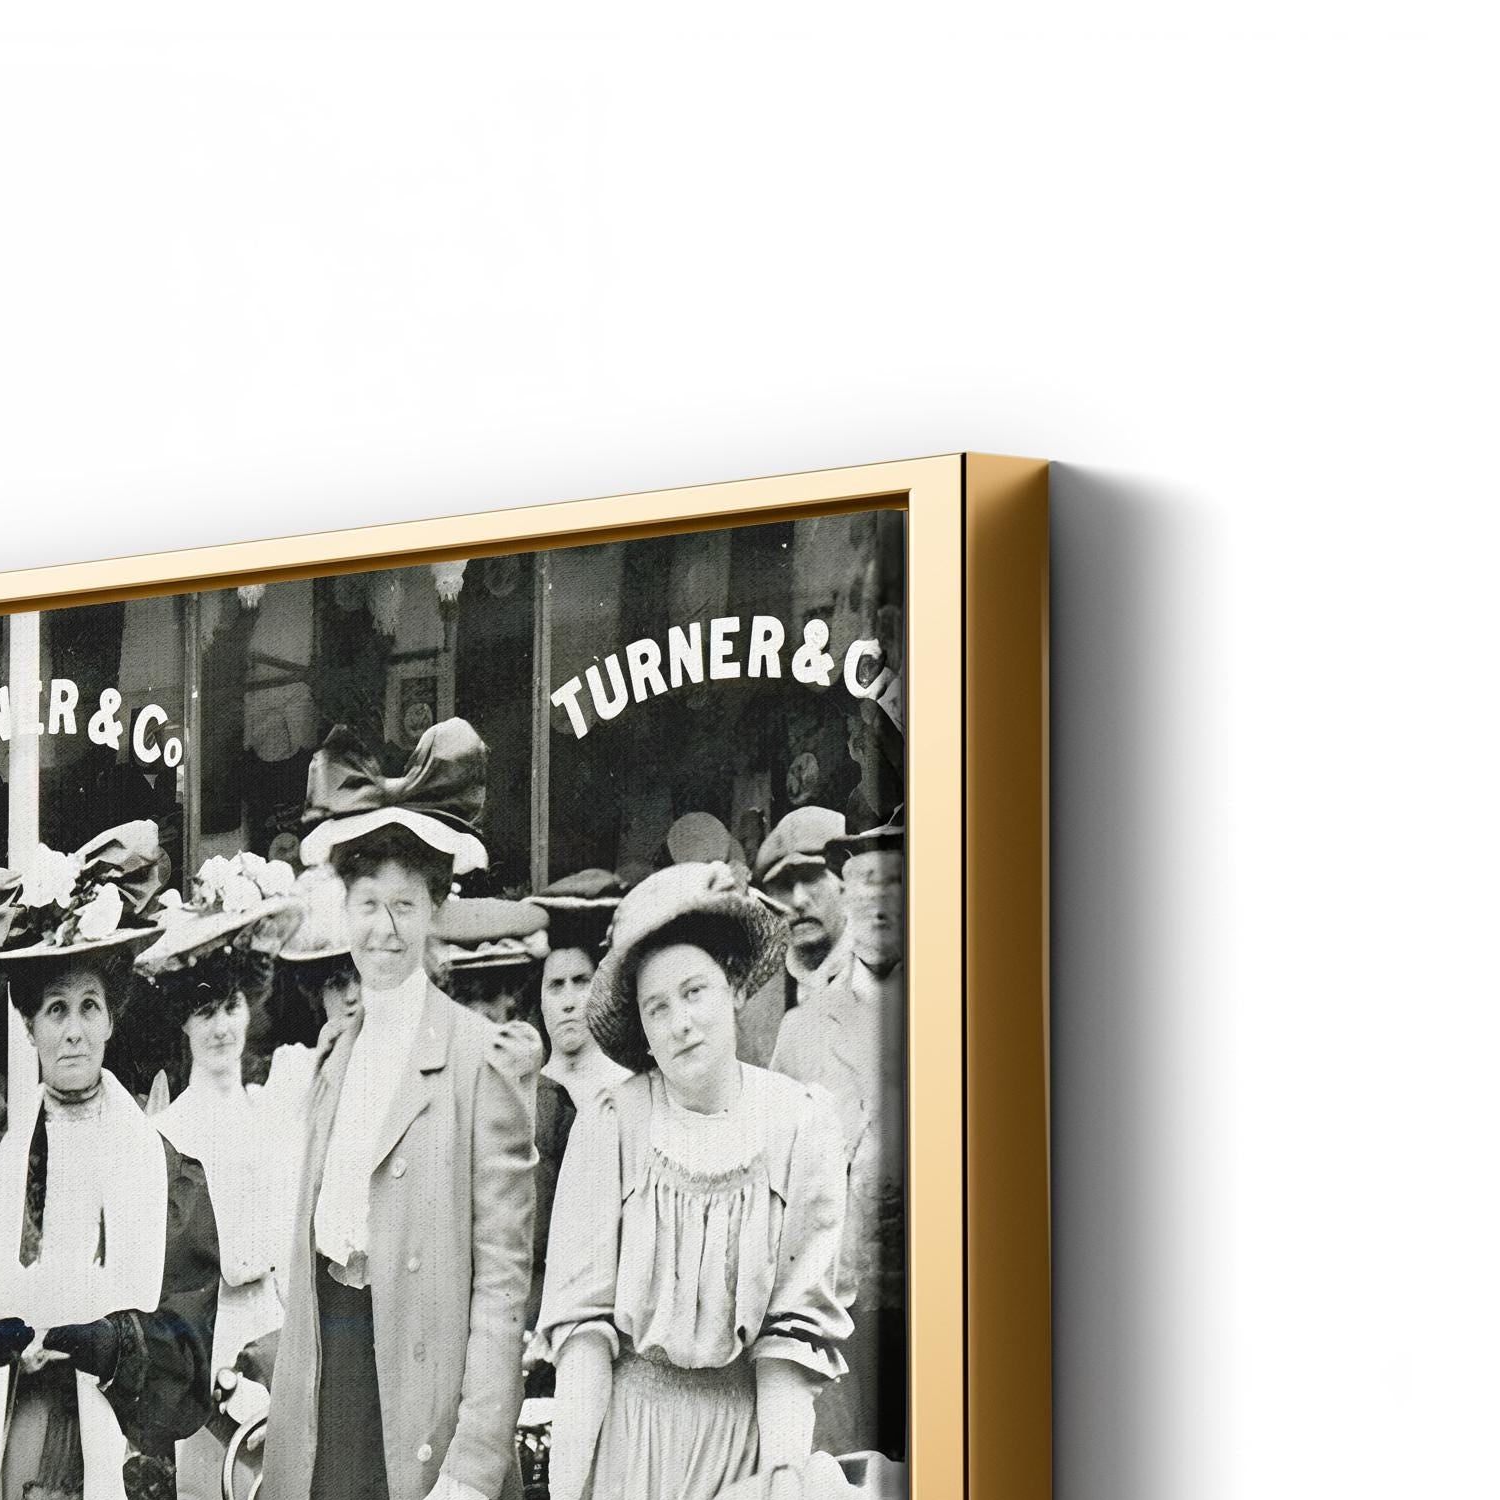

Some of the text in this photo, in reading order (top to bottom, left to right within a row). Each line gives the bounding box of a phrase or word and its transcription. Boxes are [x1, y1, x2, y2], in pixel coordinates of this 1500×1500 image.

[87, 687, 124, 750] &
[550, 615, 785, 739] TURNER
[791, 618, 835, 687] &
